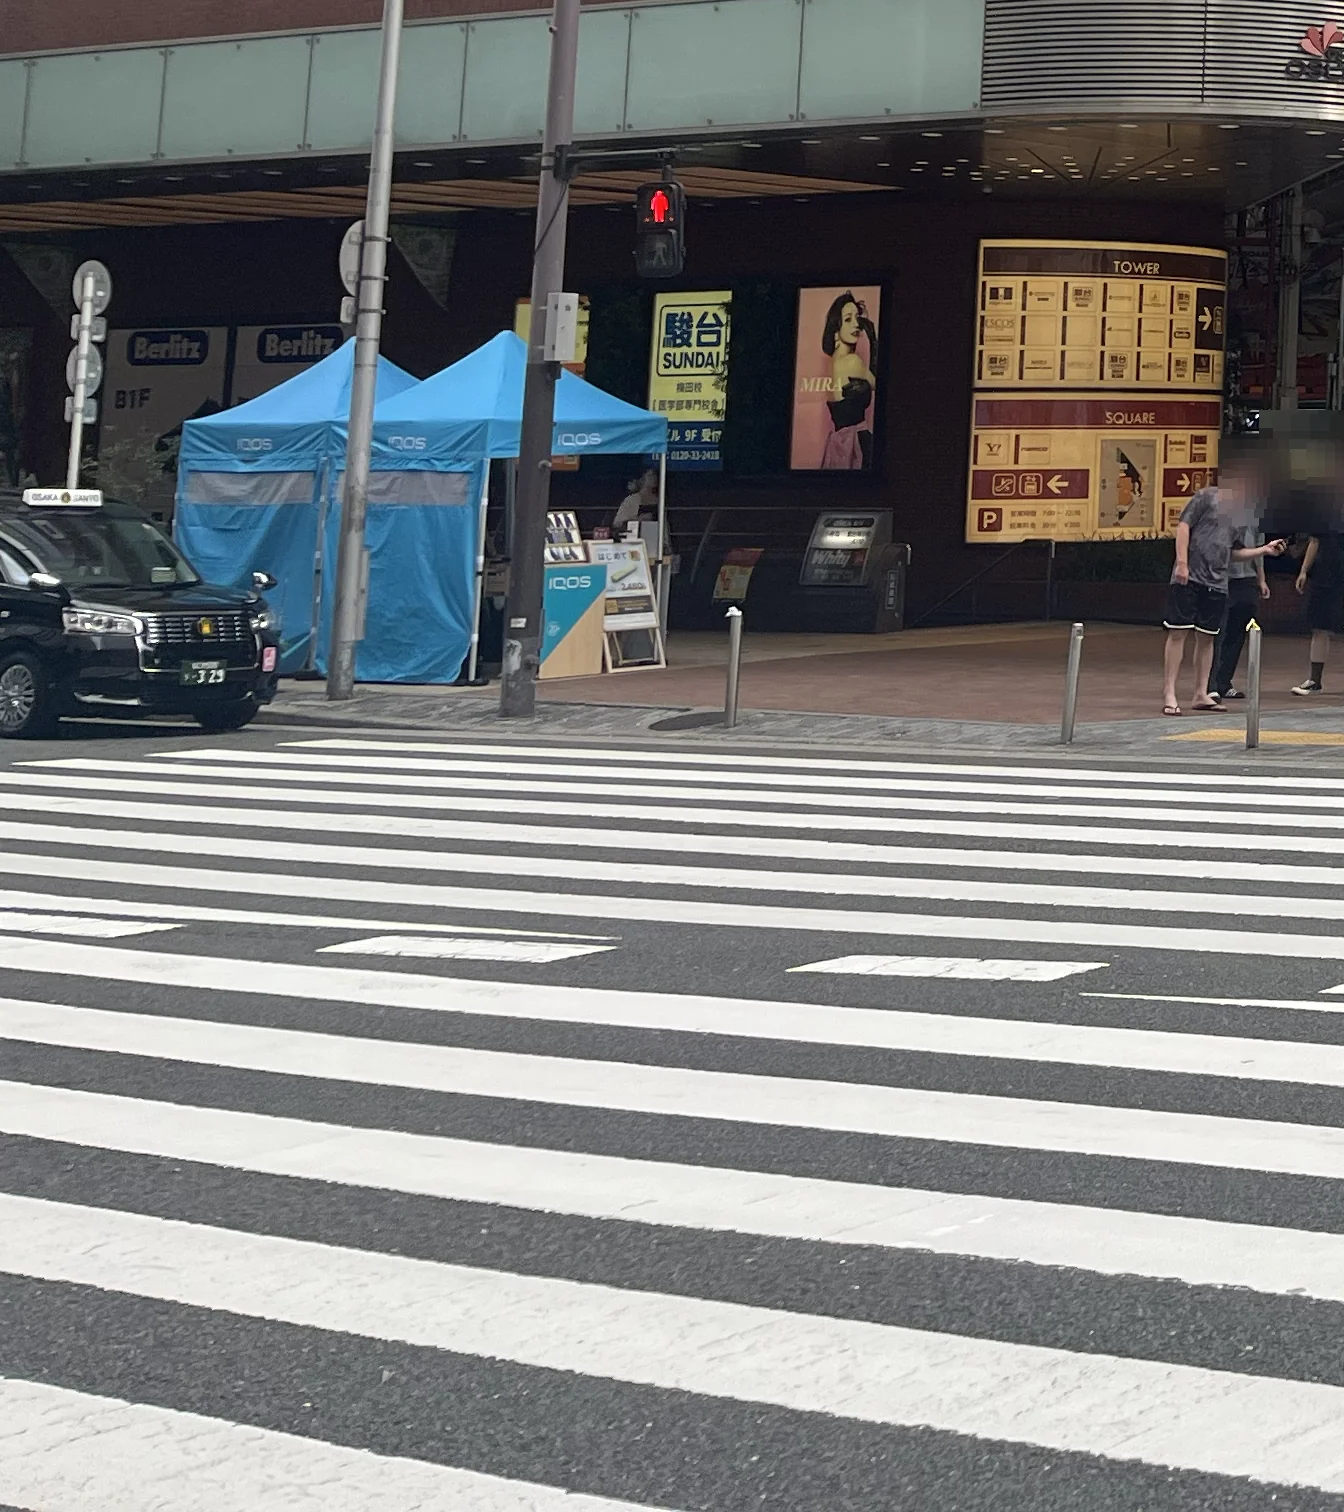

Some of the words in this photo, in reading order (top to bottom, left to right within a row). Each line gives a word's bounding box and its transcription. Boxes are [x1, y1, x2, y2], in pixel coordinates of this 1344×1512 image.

[1113, 260, 1160, 275] TOWER
[662, 310, 725, 349] 駿台
[133, 335, 202, 360] Berlitz
[264, 329, 336, 357] Berlitz
[662, 351, 721, 370] SUNDAI
[114, 389, 151, 410] B1F
[1105, 411, 1156, 425] SQUARE
[387, 435, 427, 451] IQOS
[556, 432, 602, 447] IQOS
[685, 429, 698, 442] 9F
[236, 438, 273, 451] IQOS
[810, 548, 852, 569] Whity
[549, 575, 592, 591] IQOS
